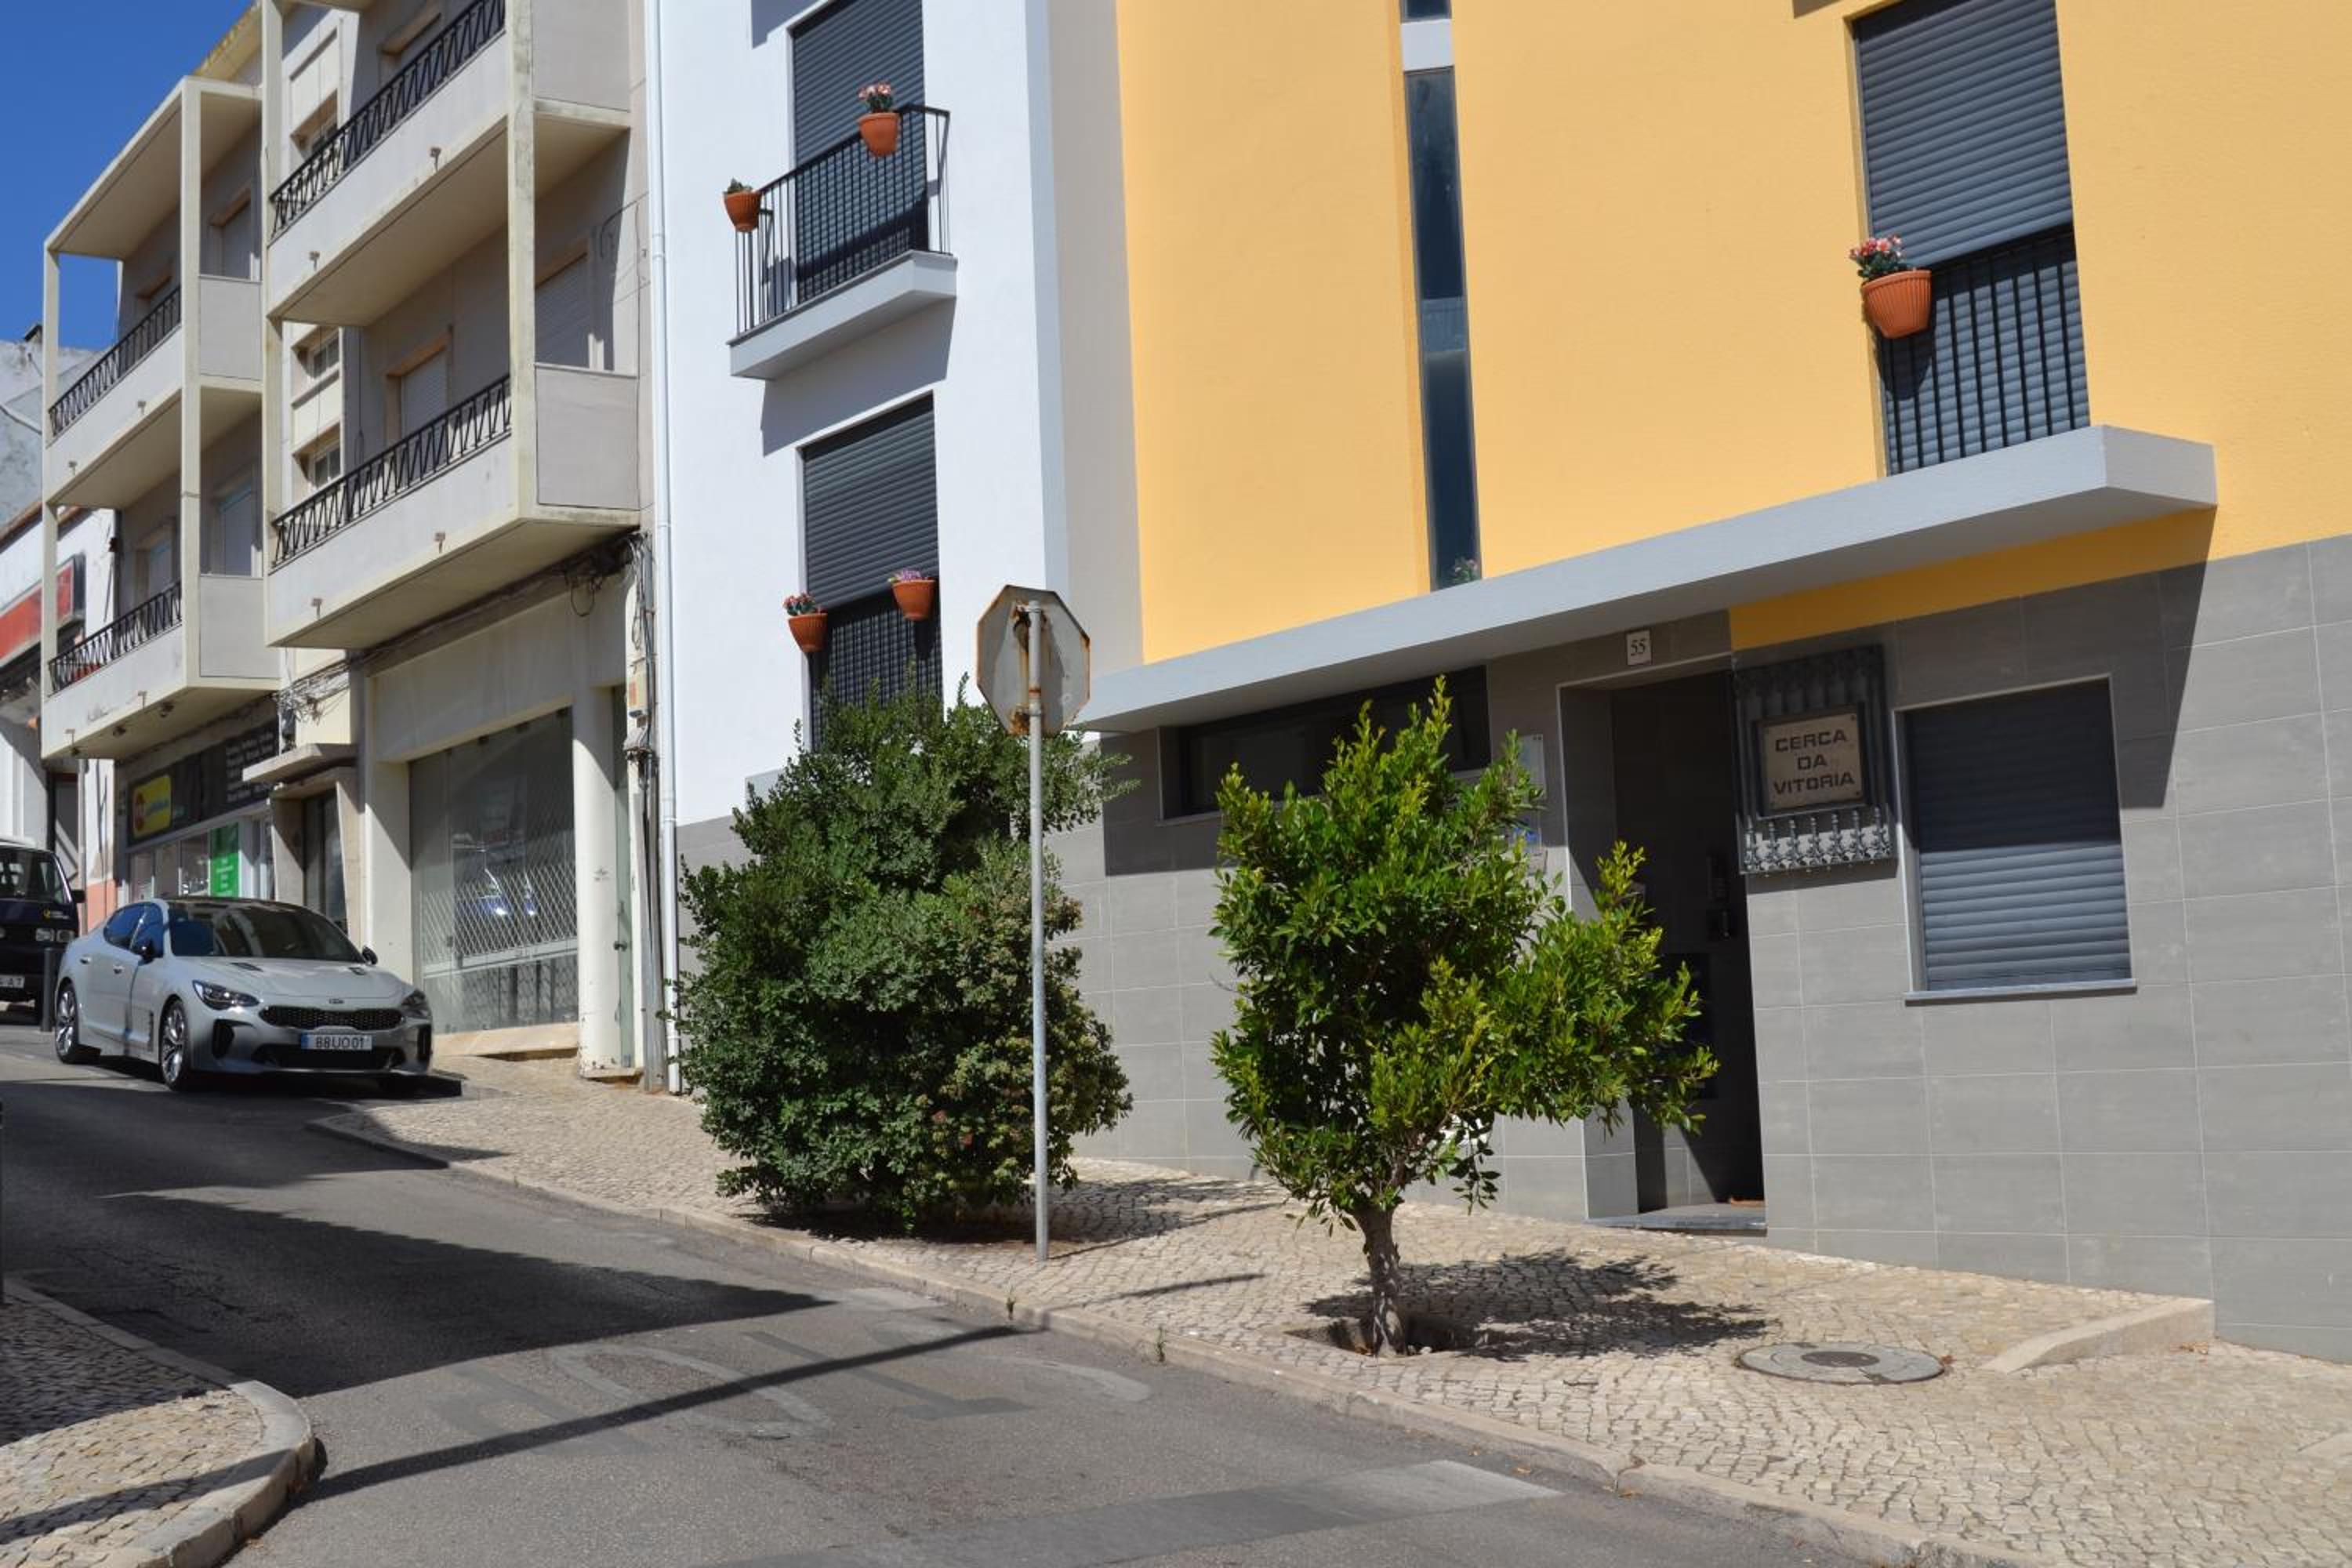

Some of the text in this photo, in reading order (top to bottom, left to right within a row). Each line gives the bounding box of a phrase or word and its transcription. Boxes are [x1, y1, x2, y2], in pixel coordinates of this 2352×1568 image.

[1775, 729, 1847, 753] CERCA
[1797, 753, 1828, 771] DA
[1773, 771, 1856, 795] VITORIA
